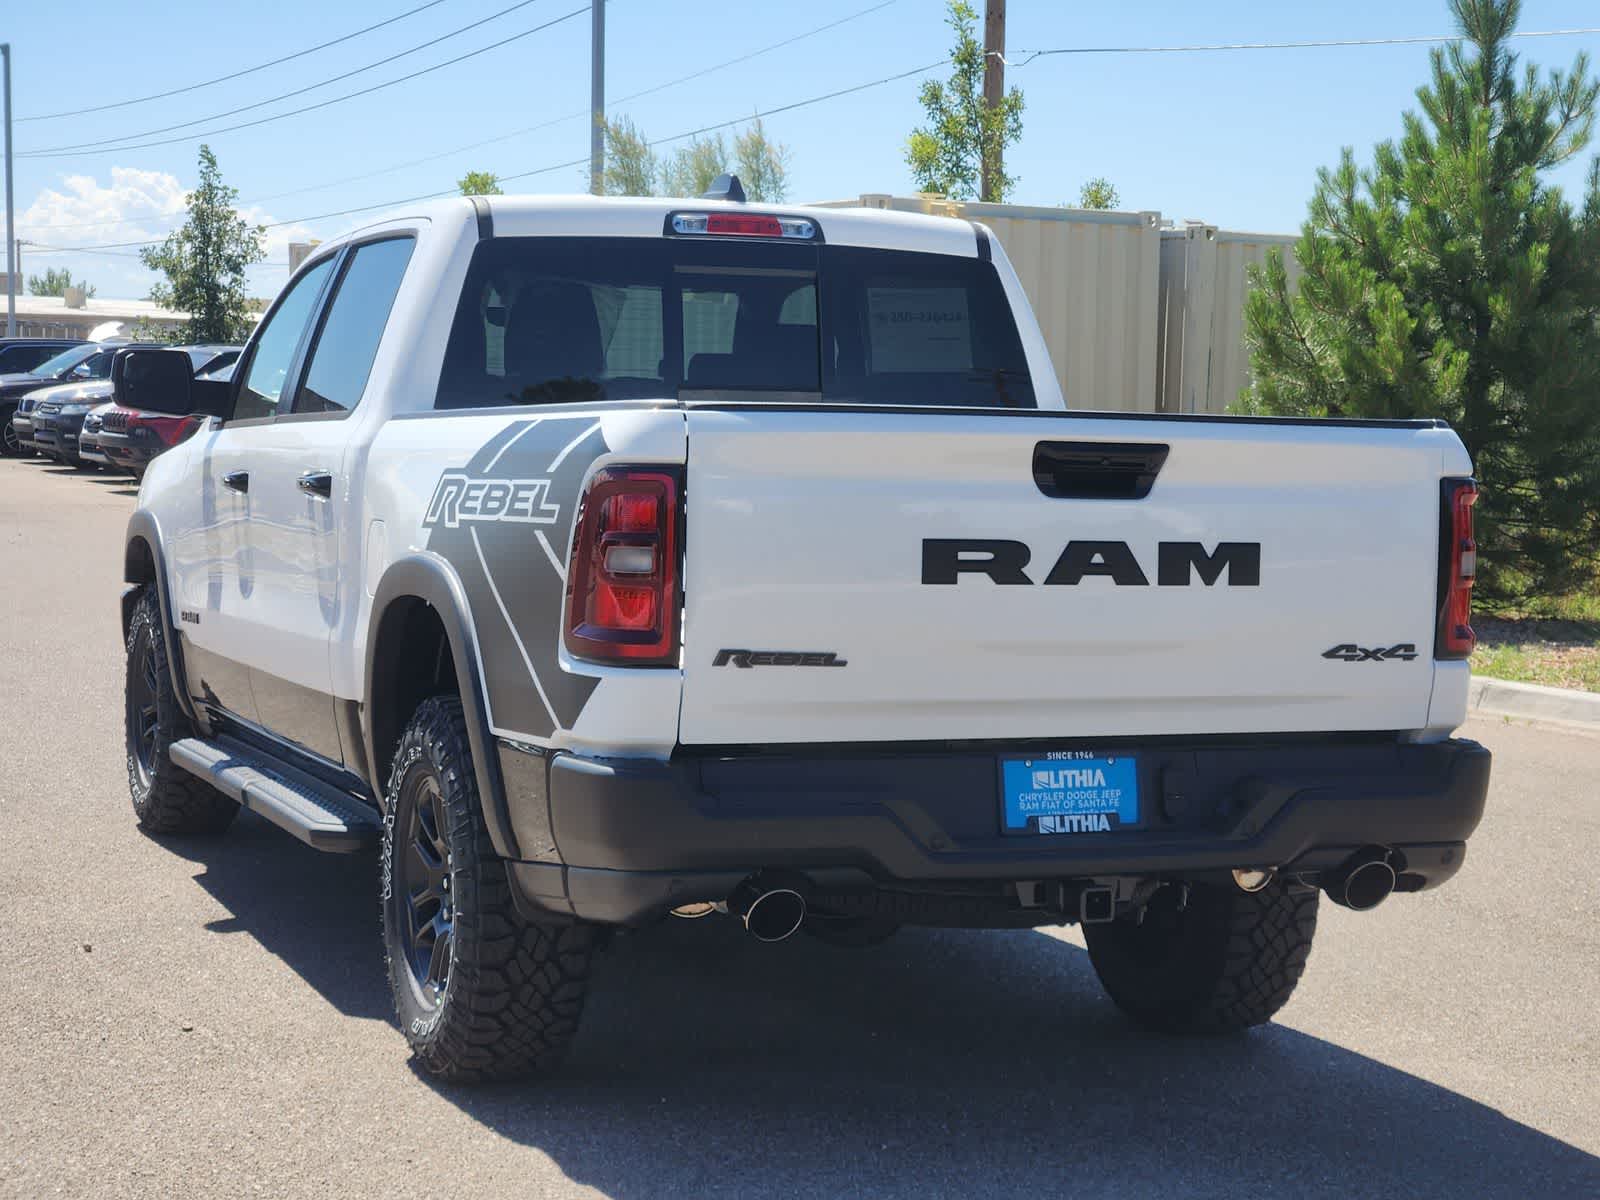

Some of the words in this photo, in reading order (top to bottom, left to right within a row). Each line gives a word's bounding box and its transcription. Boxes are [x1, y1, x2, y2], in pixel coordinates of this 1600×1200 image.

[426, 474, 560, 528] REBEL
[921, 538, 1261, 586] RAM
[712, 649, 848, 668] REBEL
[1047, 752, 1073, 760] SINCE
[1049, 768, 1106, 789] LITHIA
[1019, 791, 1065, 802] CHRYSLER
[1067, 790, 1097, 800] DODGE
[1101, 789, 1121, 799] JEEP
[1019, 801, 1040, 811] RAM
[1041, 801, 1060, 810] FIAT
[1063, 800, 1075, 809] OF
[1078, 799, 1106, 808] SANTA
[1108, 798, 1121, 807] FE
[1054, 814, 1111, 833] LITHIA
